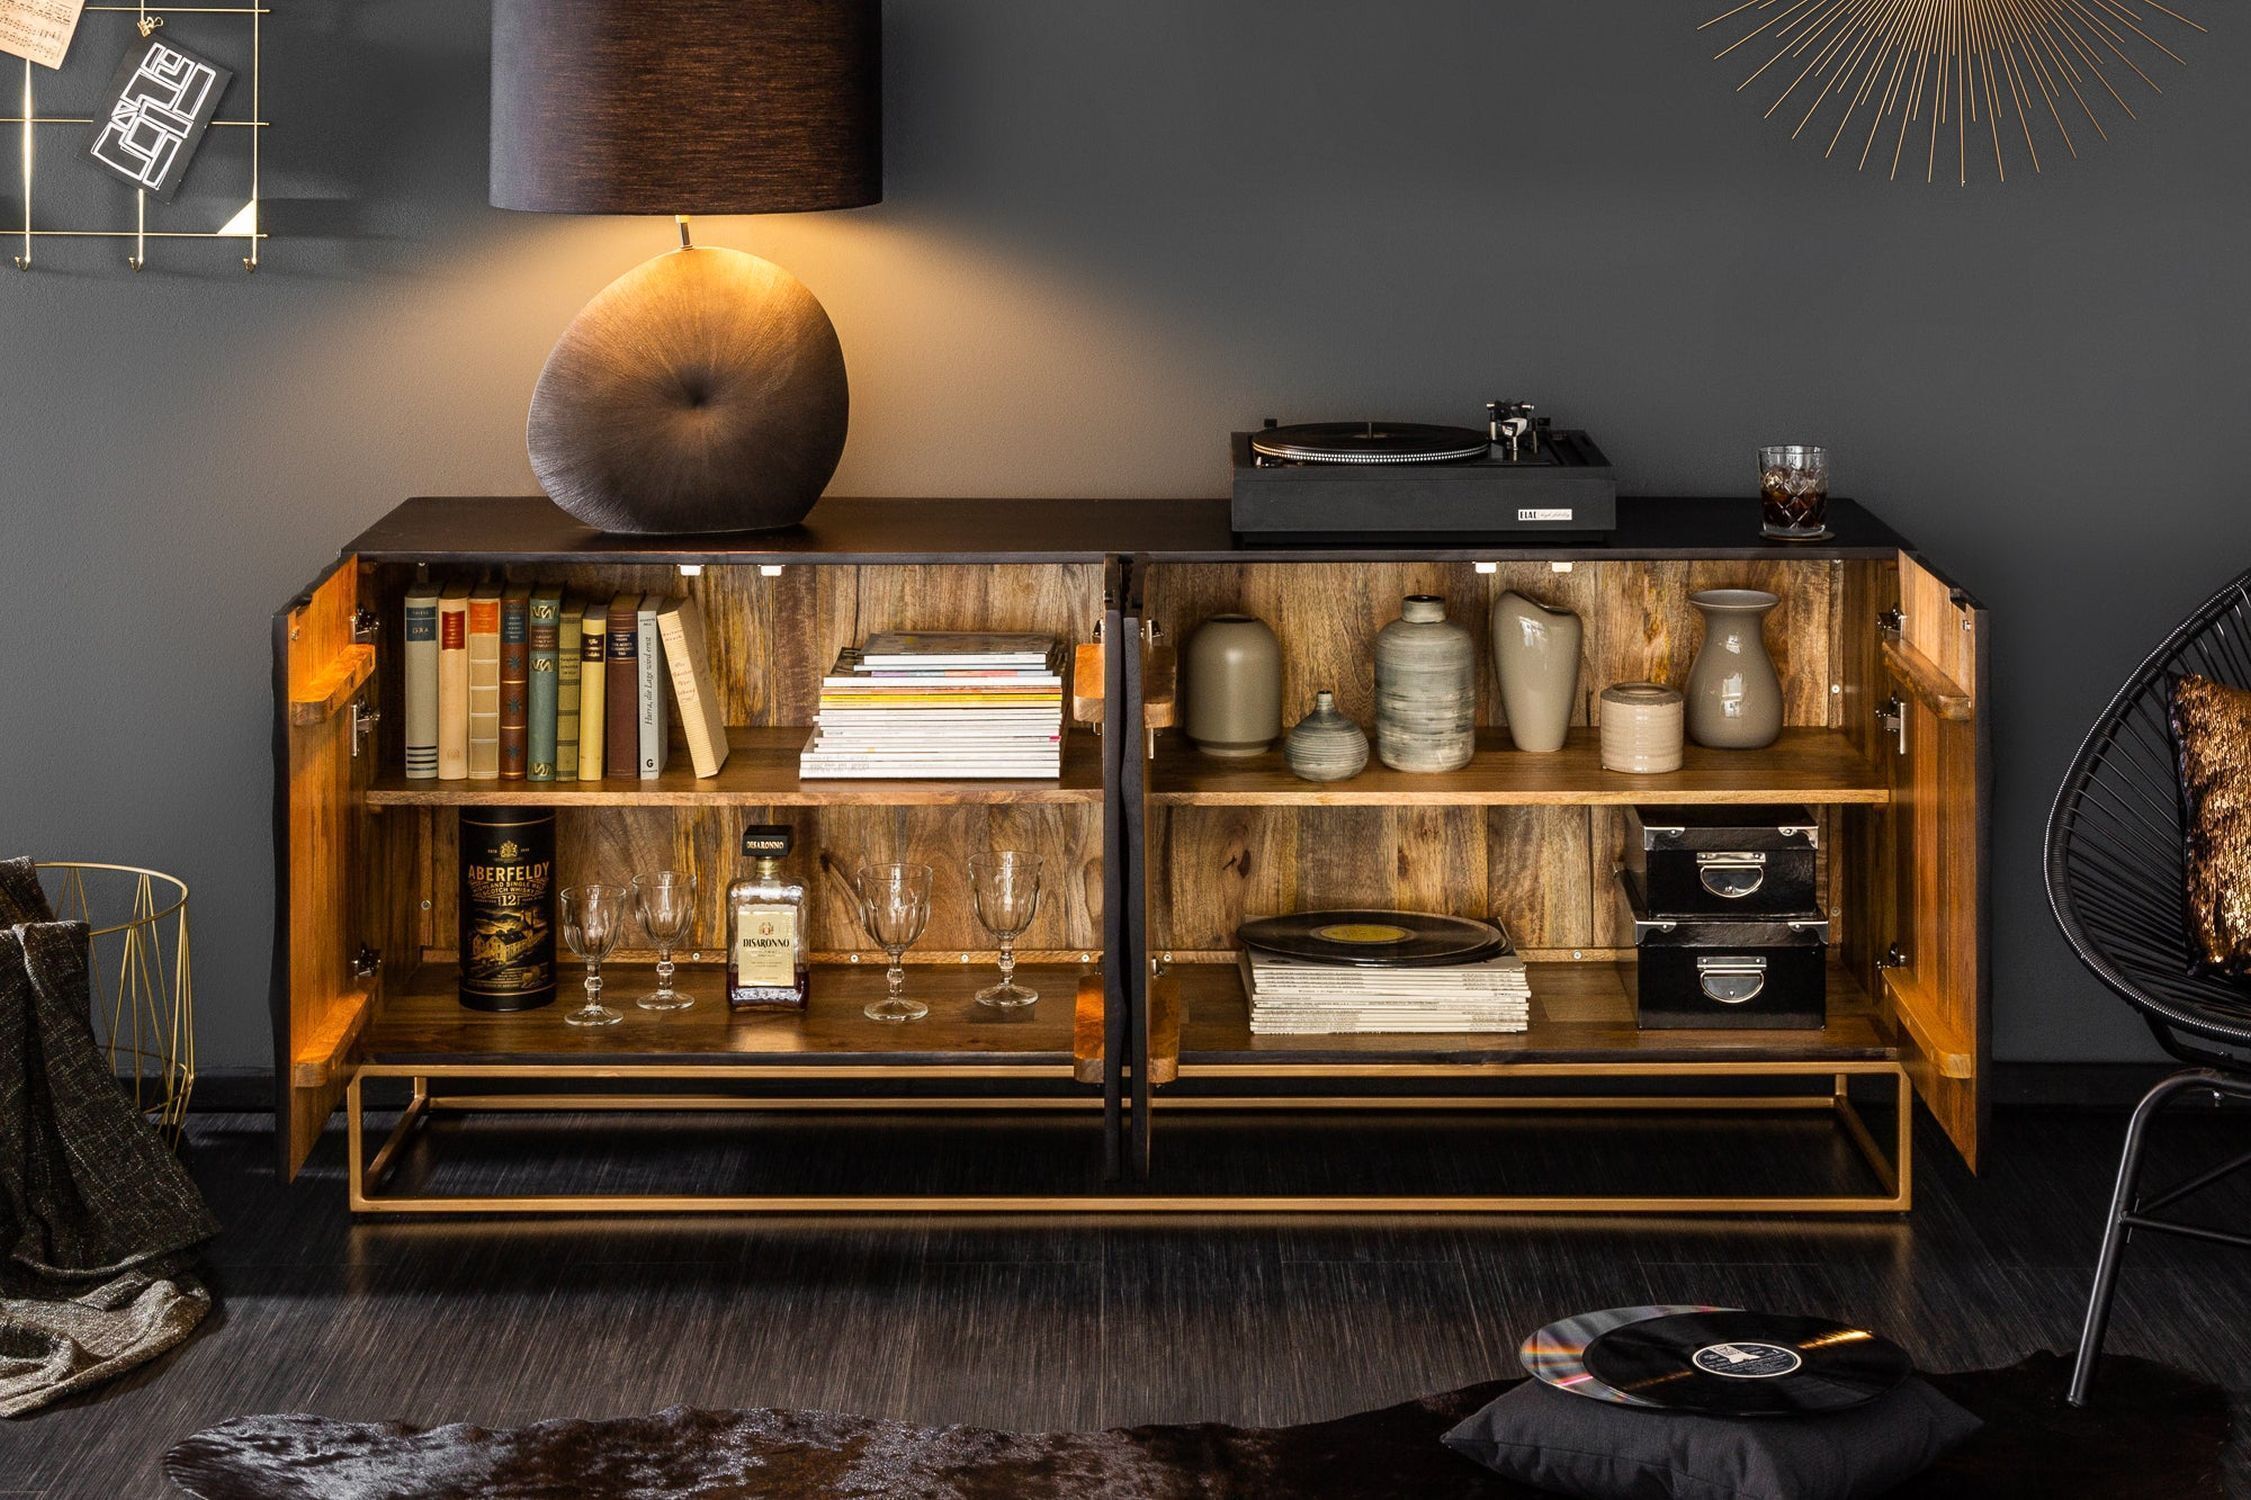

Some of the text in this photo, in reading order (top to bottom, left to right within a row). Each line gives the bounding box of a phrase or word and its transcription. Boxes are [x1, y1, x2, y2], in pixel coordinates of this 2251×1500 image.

[646, 758, 655, 768] G
[746, 840, 784, 850] DISARONNO
[468, 861, 550, 882] ABERFELDY
[502, 895, 517, 906] 12
[743, 938, 790, 949] DISARONNO
